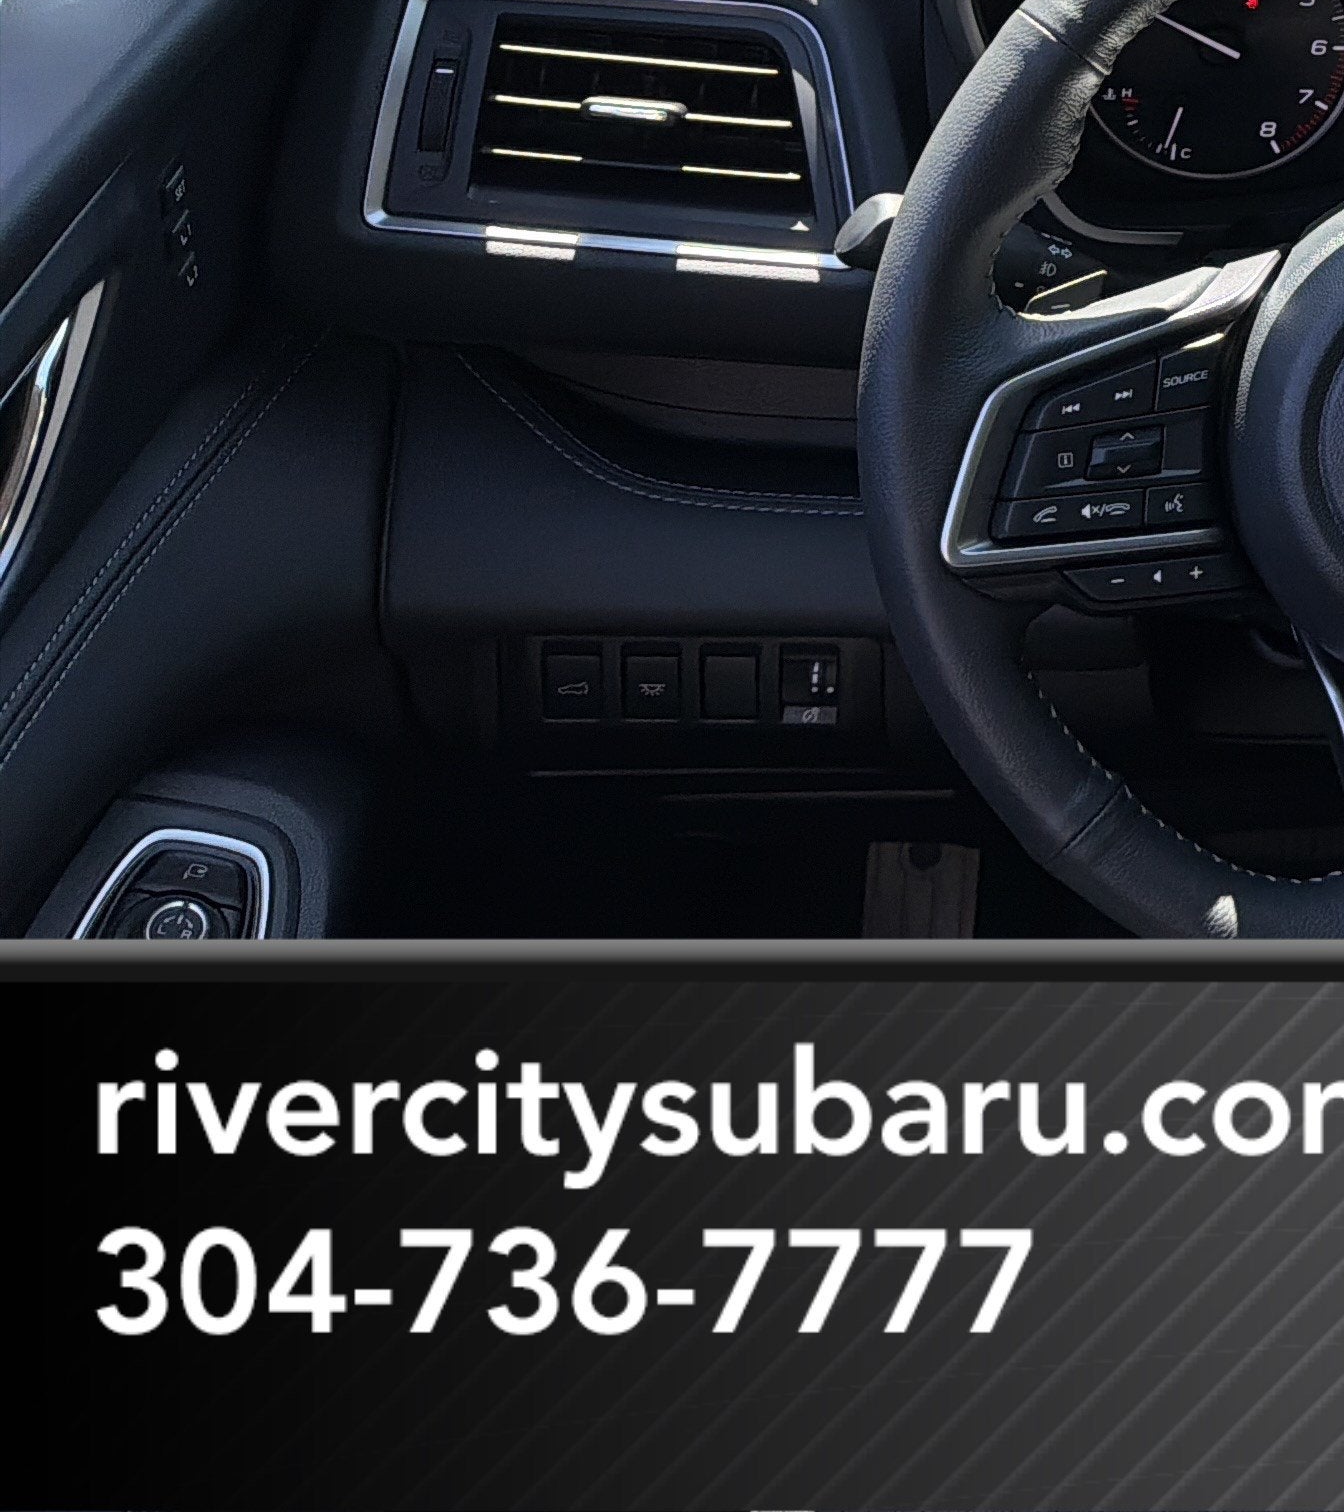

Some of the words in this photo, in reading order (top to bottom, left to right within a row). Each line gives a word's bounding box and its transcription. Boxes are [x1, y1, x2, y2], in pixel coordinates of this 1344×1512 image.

[1310, 39, 1328, 56] 6
[1121, 88, 1133, 97] H
[1298, 88, 1315, 104] 7
[1259, 121, 1277, 137] 8
[1180, 149, 1192, 160] C
[1163, 369, 1209, 388] SOURCE
